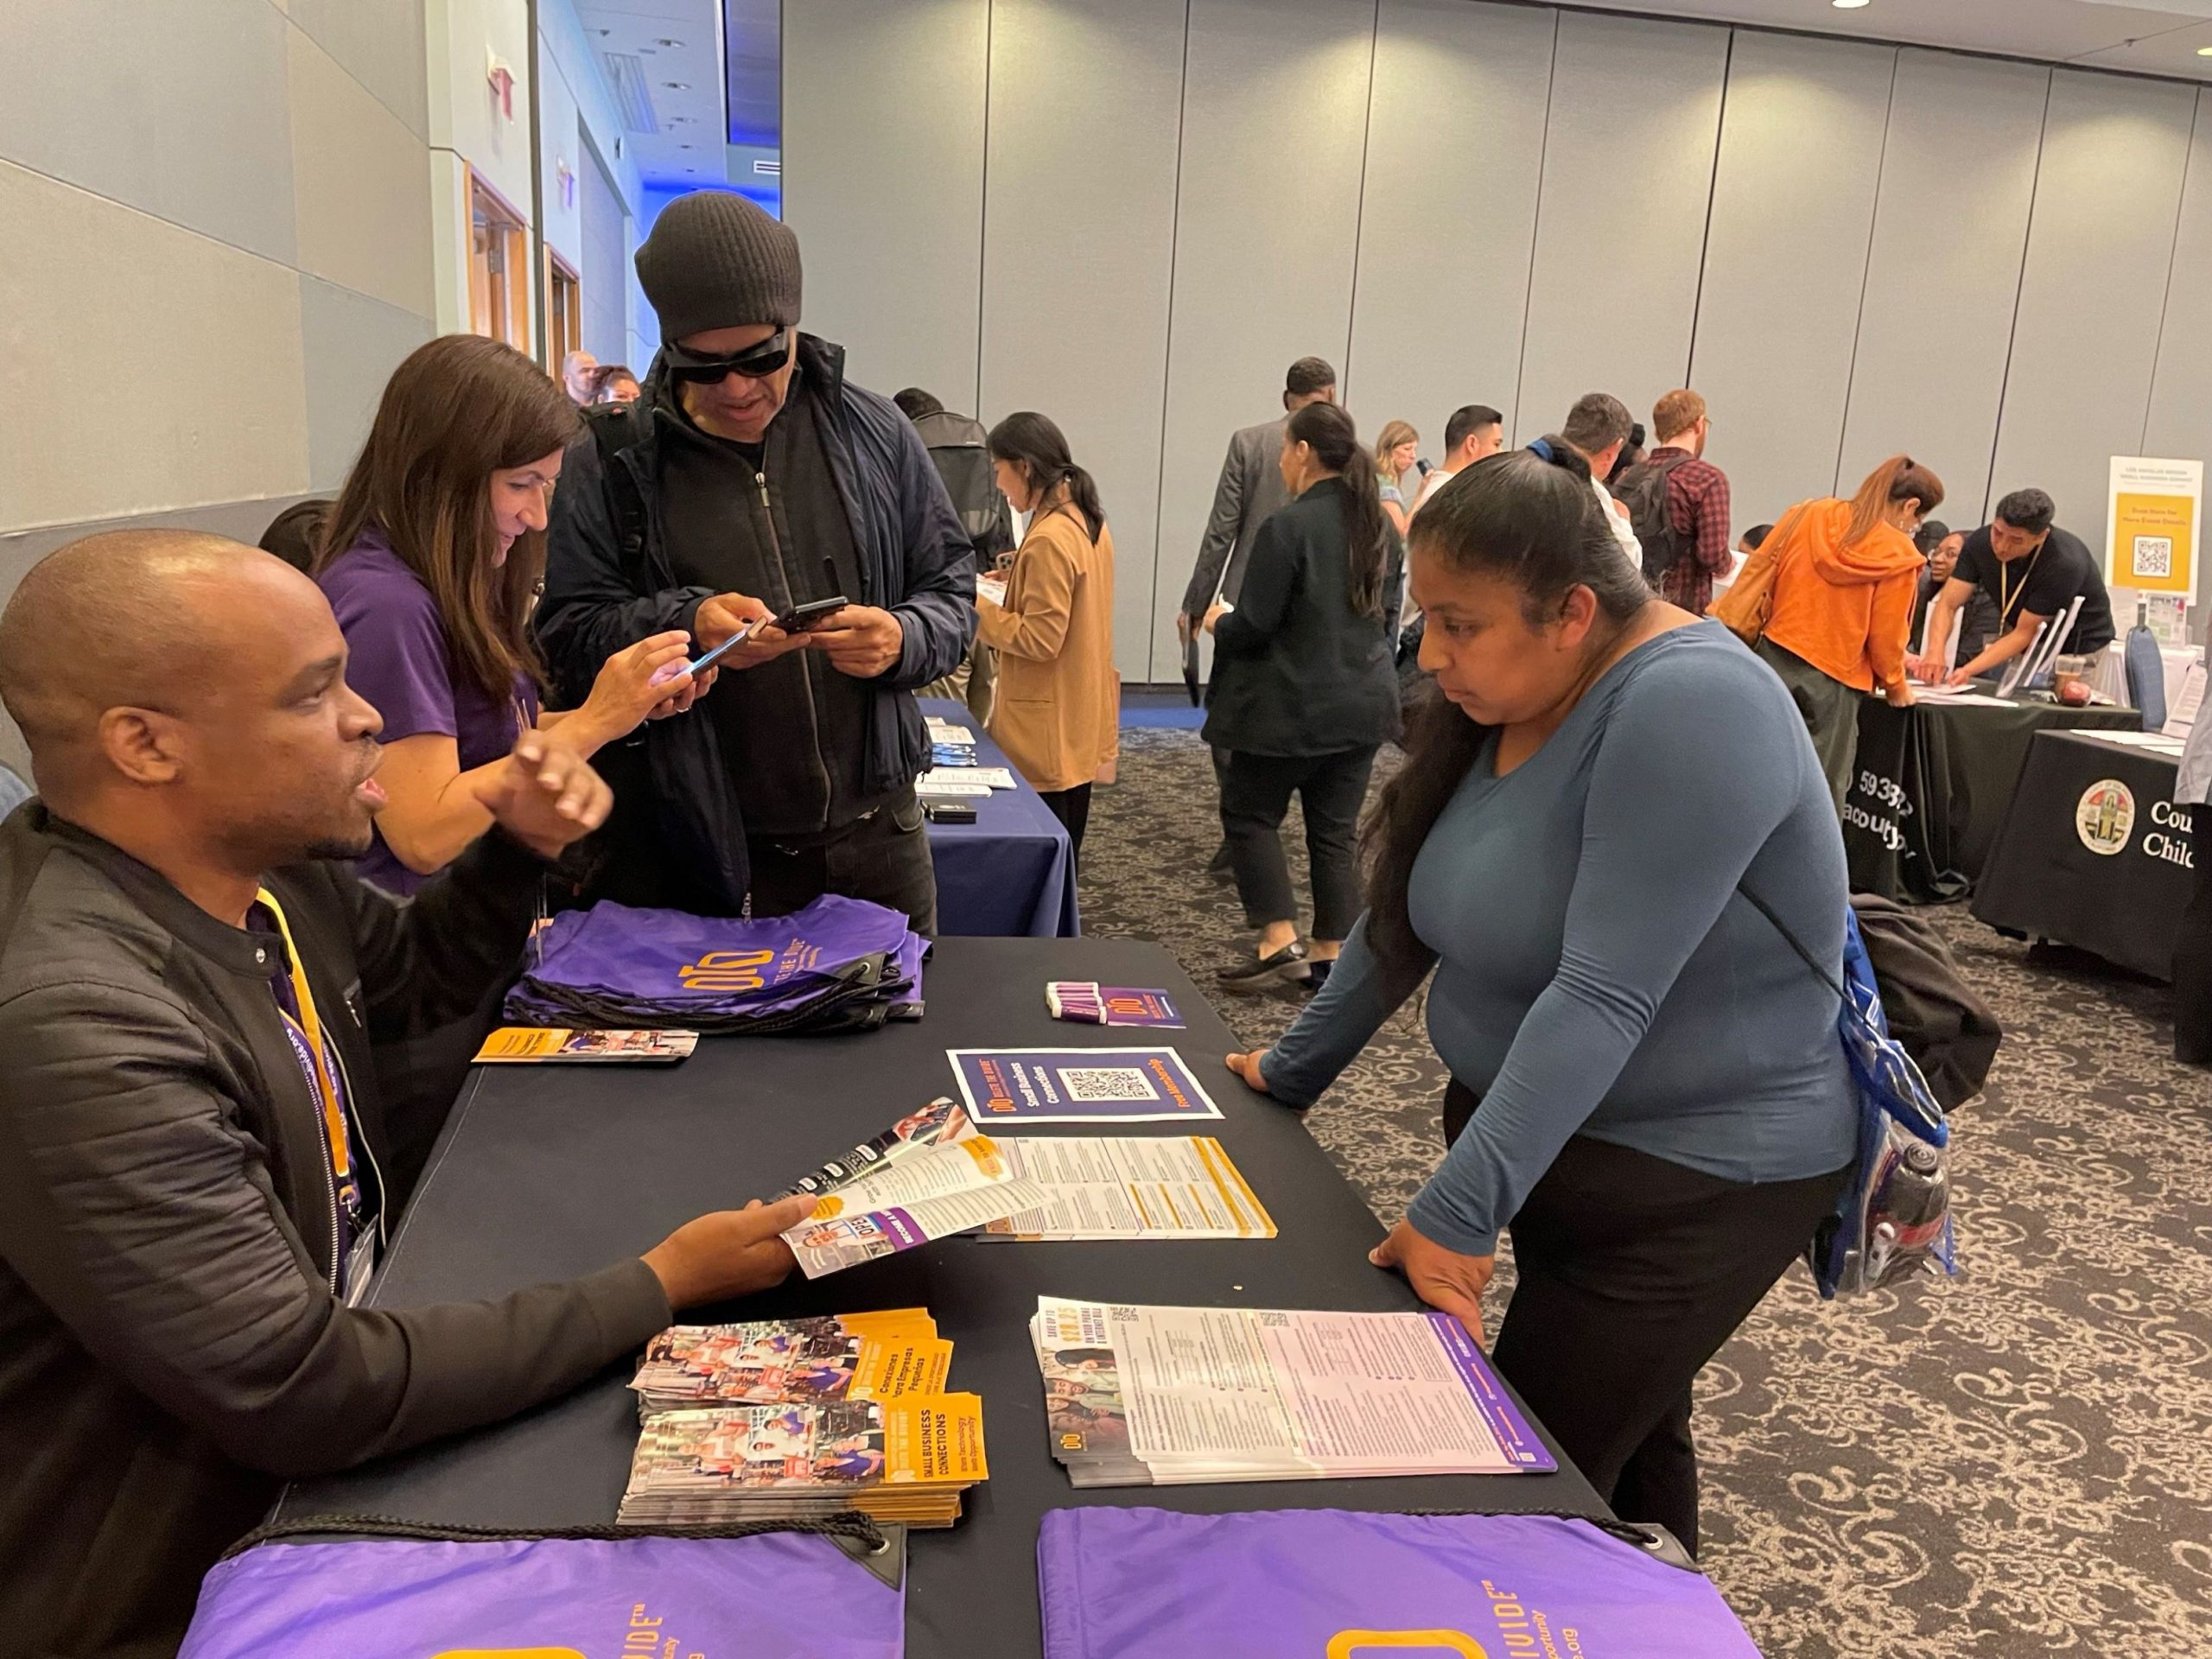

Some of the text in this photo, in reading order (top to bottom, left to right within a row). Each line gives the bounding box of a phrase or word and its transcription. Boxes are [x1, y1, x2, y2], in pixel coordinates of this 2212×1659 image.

[1010, 1062, 1039, 1107] Small Business
[1033, 1065, 1060, 1104] Connections
[1147, 1058, 1191, 1107] Free Membership
[1046, 1325, 1058, 1338] SAVE
[1083, 1325, 1093, 1336] YOUR
[1093, 1319, 1106, 1340] INTERNET
[880, 1353, 899, 1394] Conexiones
[901, 1348, 913, 1382] Empresas
[908, 1357, 925, 1391] Pequeñas
[921, 1409, 933, 1478] SMALL BUSINESS
[936, 1414, 949, 1475] CONNECTIONS
[957, 1416, 967, 1456] Technology
[967, 1415, 978, 1457] Opportunity
